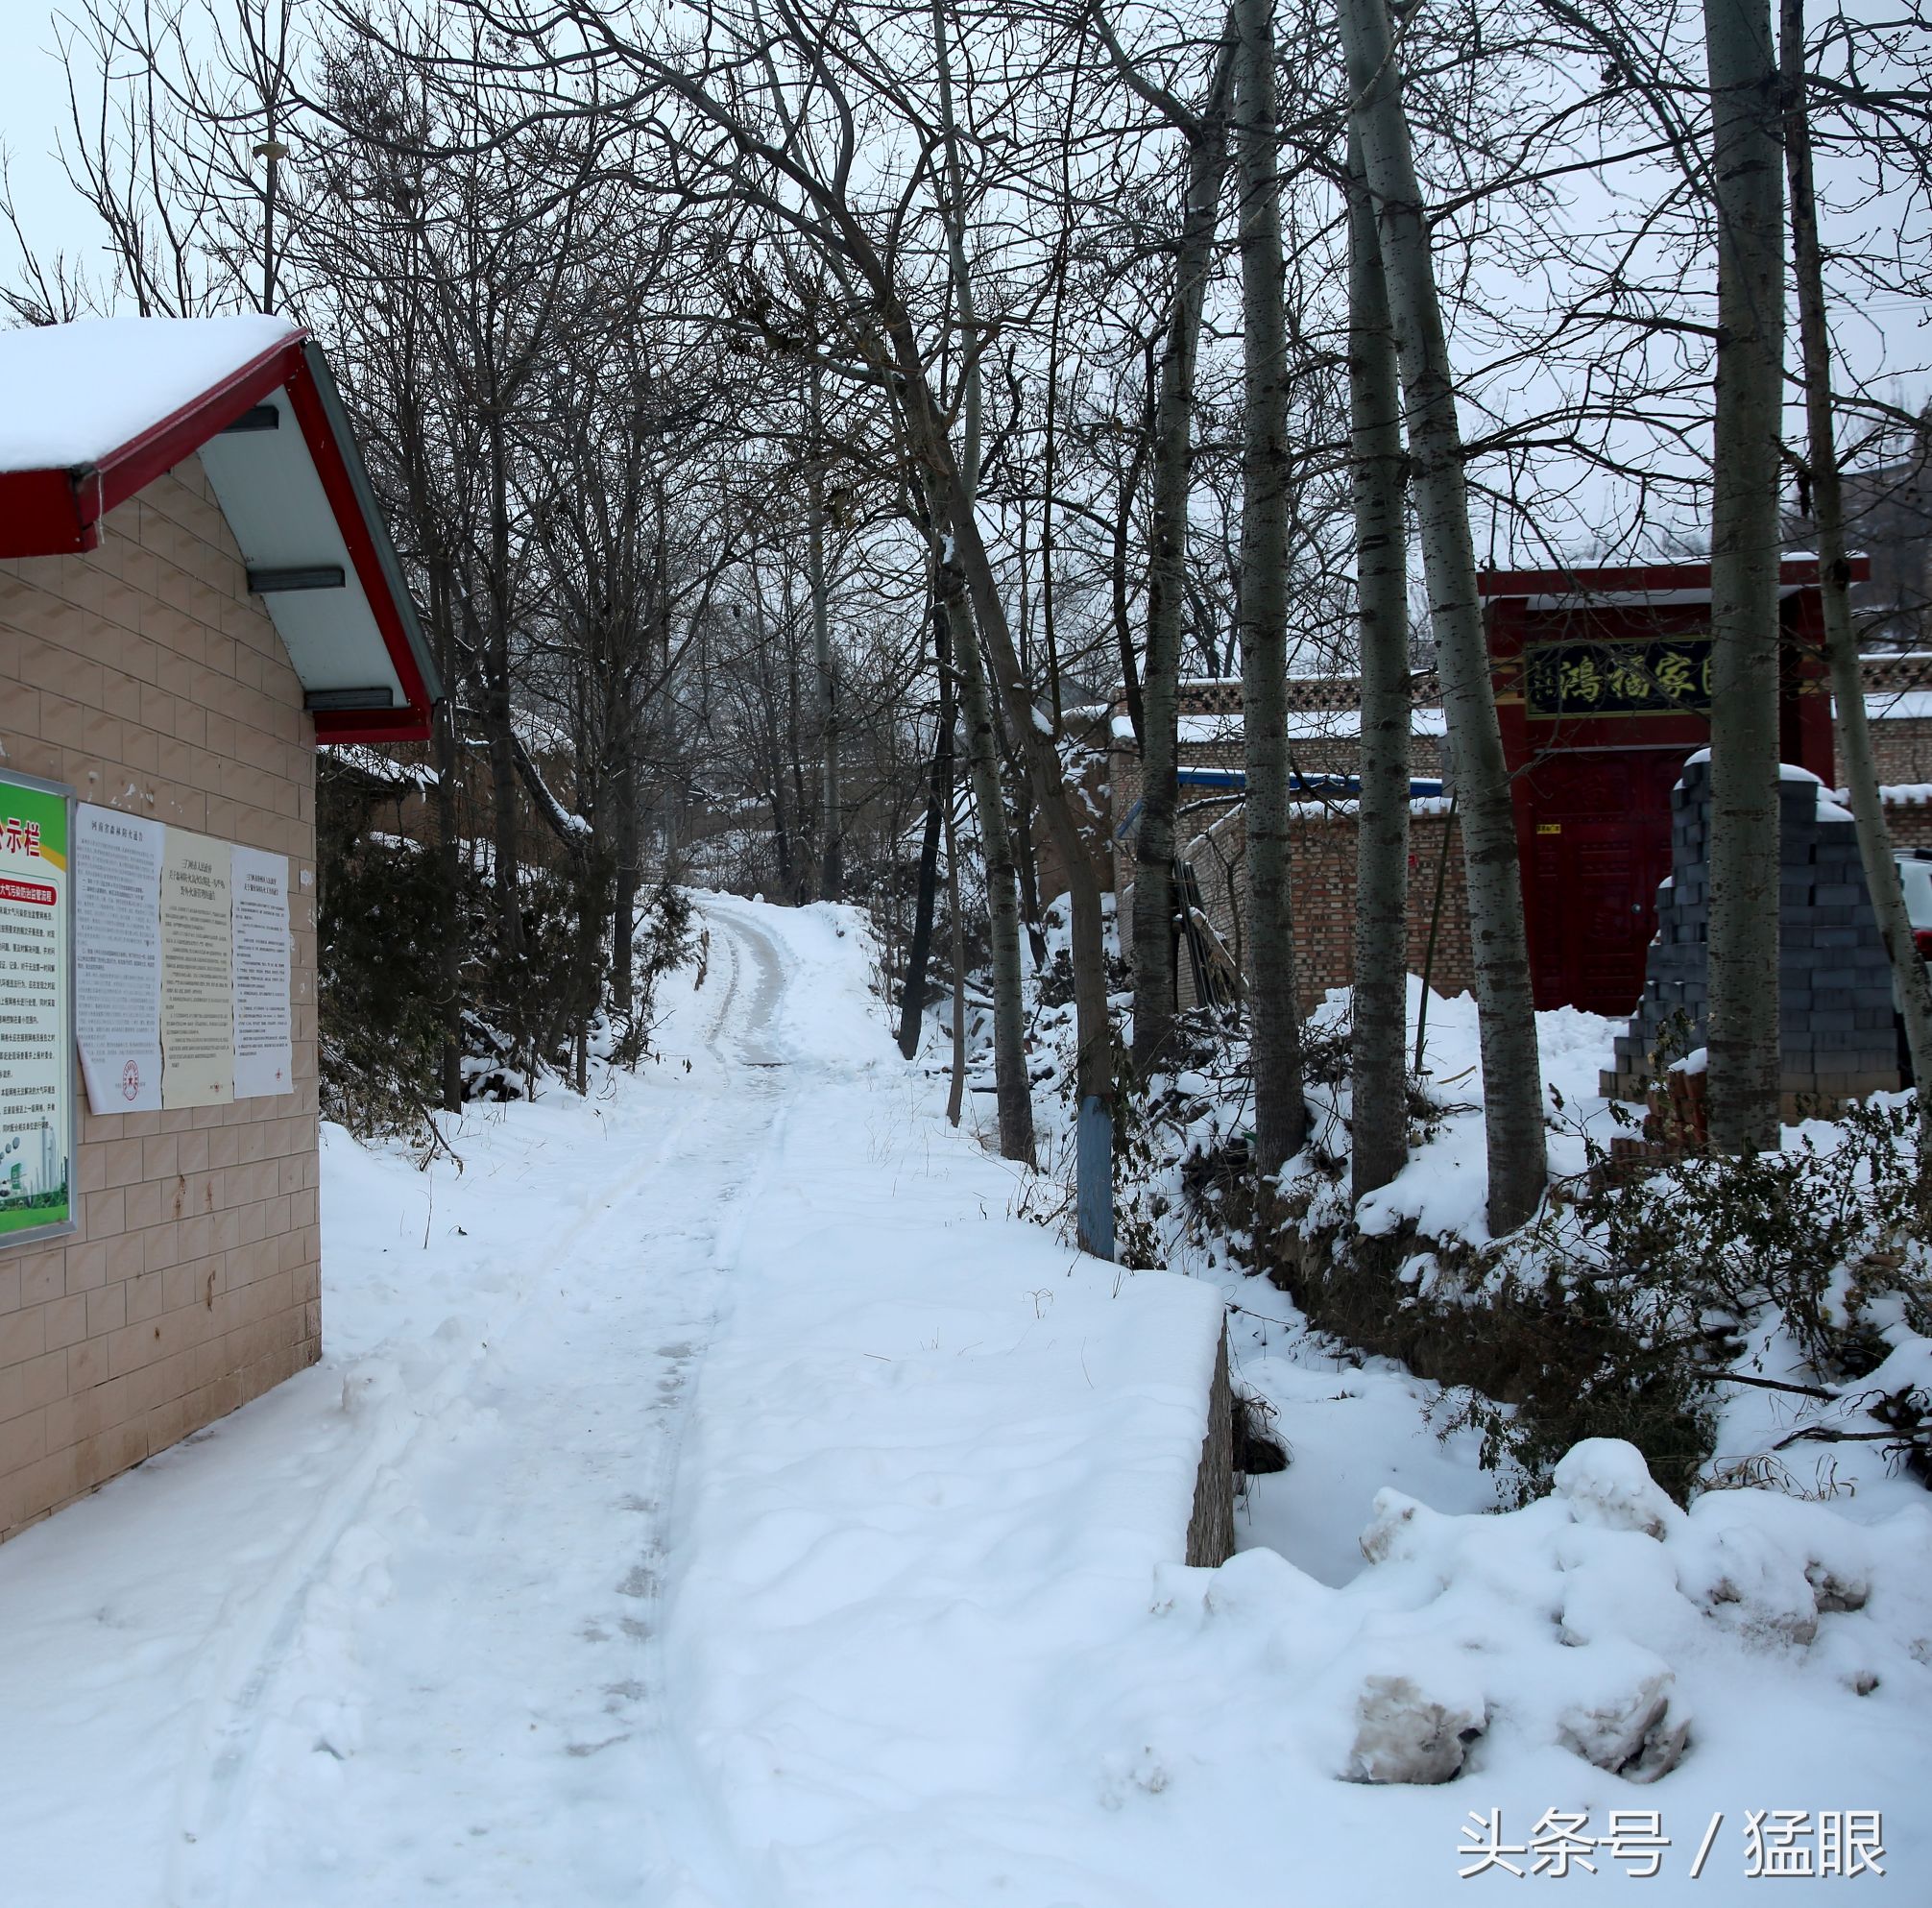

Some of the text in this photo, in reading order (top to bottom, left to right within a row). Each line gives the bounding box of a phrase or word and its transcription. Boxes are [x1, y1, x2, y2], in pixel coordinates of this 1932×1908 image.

[1558, 651, 1714, 702] 鸿福家
[0, 818, 40, 857] 示栏
